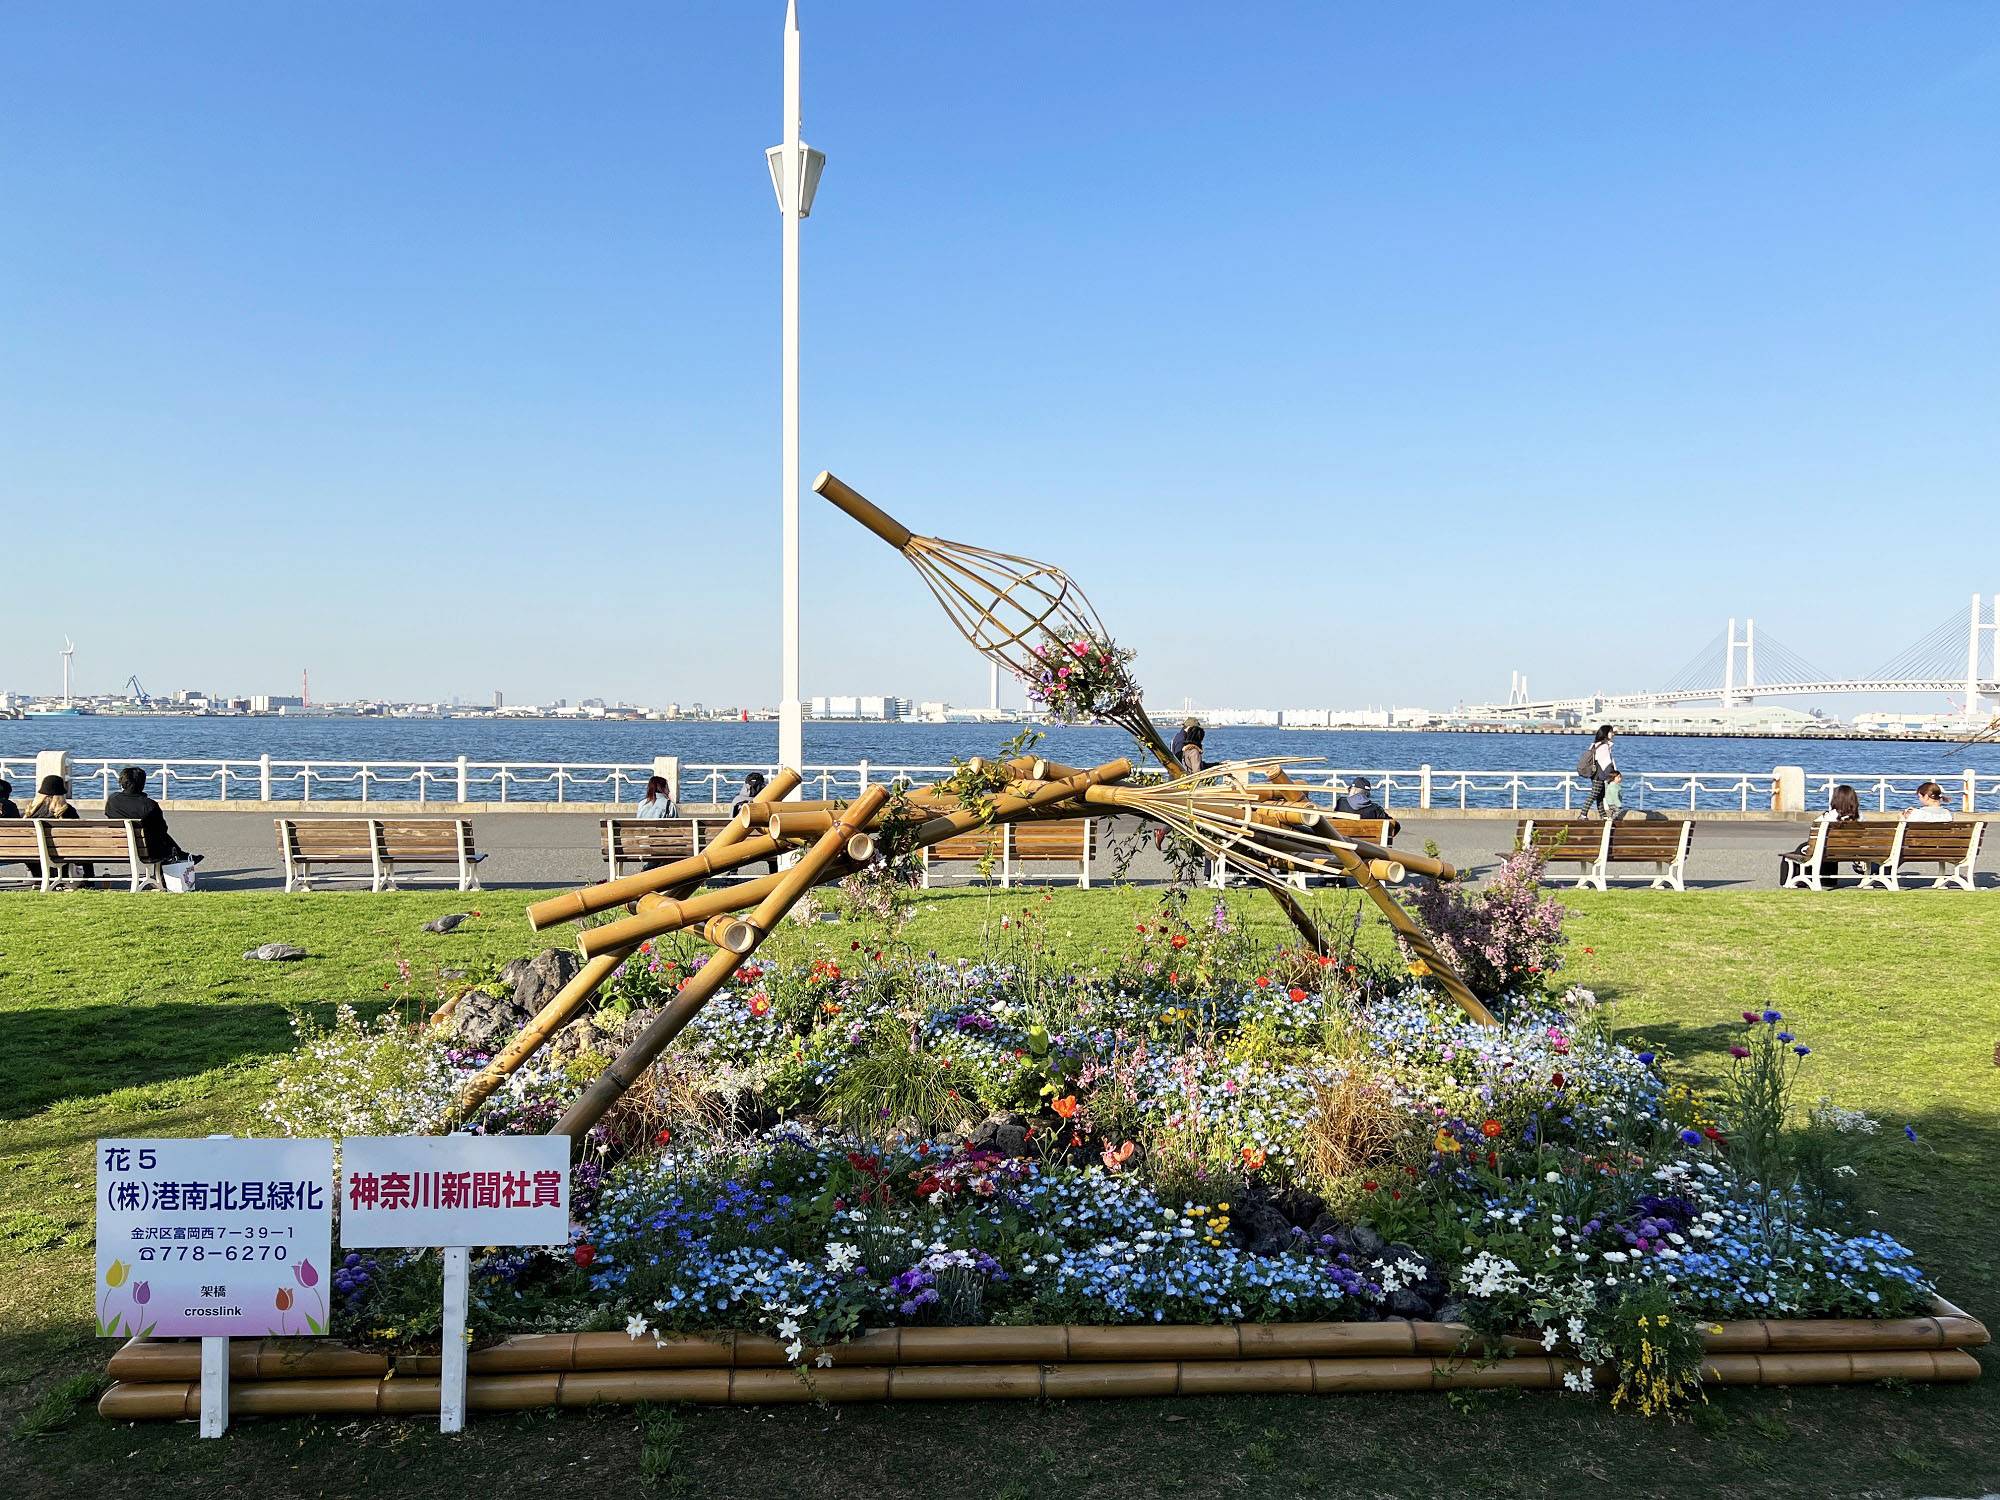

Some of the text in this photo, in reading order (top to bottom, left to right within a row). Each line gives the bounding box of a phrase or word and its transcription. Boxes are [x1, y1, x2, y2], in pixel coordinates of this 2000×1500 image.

[108, 1180, 324, 1212] (株)港南北見緑化
[349, 1170, 562, 1211] 神奈川新聞社賞
[200, 1285, 227, 1298] 架橋
[184, 1305, 242, 1317] crosslink
